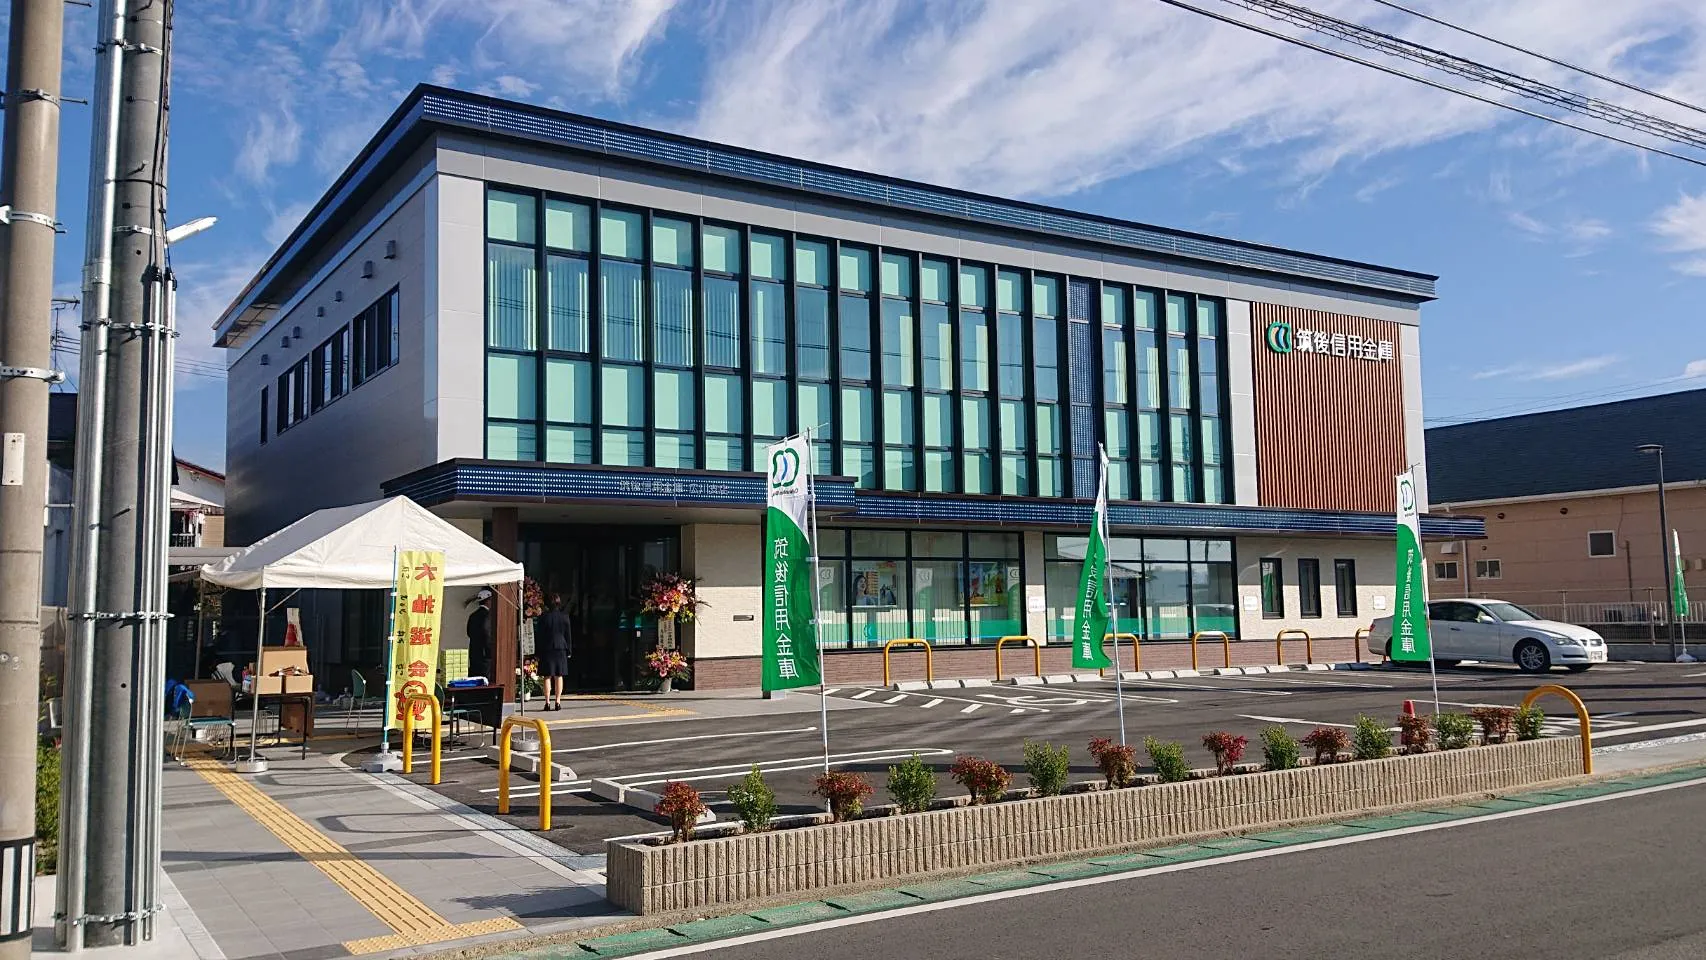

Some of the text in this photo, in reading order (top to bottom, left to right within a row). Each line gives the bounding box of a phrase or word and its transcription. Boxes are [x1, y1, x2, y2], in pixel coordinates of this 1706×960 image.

[1296, 328, 1393, 361] 筑後信用金庫
